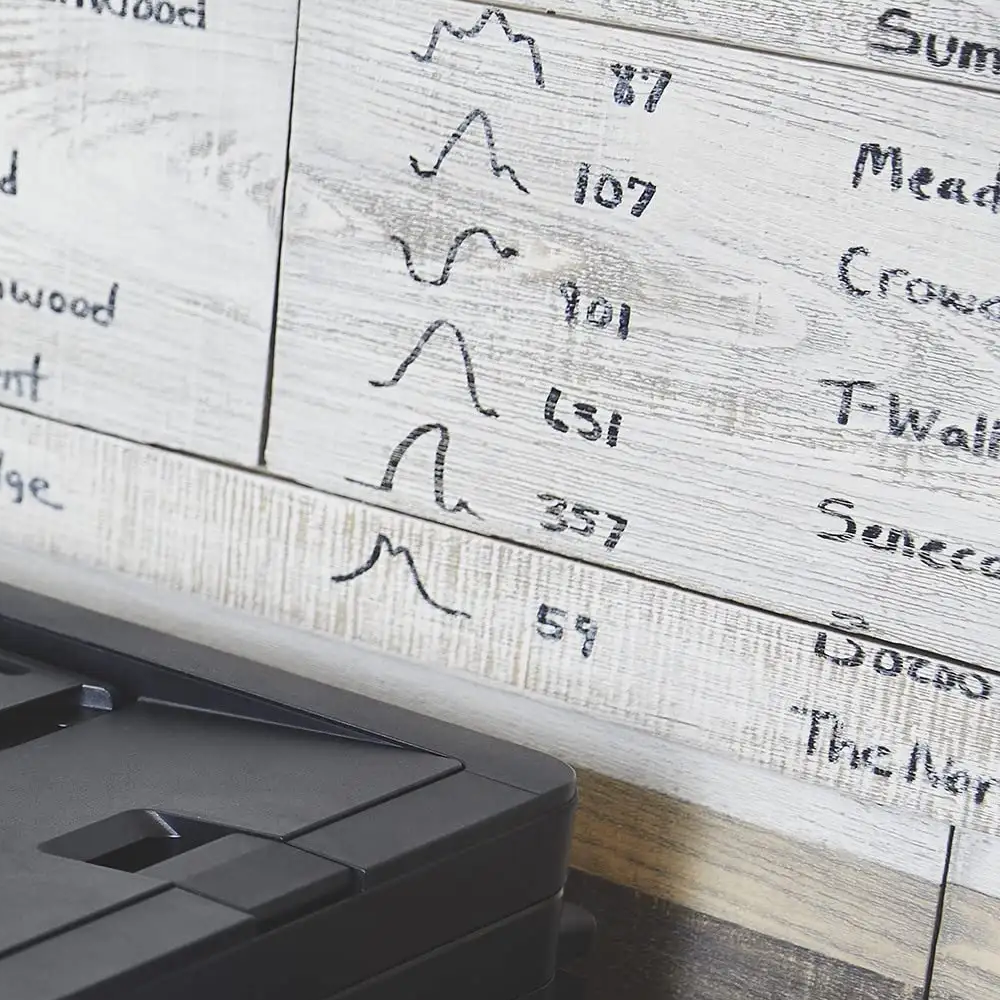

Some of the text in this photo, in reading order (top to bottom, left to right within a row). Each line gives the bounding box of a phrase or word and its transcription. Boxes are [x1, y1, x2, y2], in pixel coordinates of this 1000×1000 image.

[573, 162, 657, 218] 107
[536, 491, 629, 552] 357
[536, 602, 599, 659] 59
[790, 704, 893, 779] The
